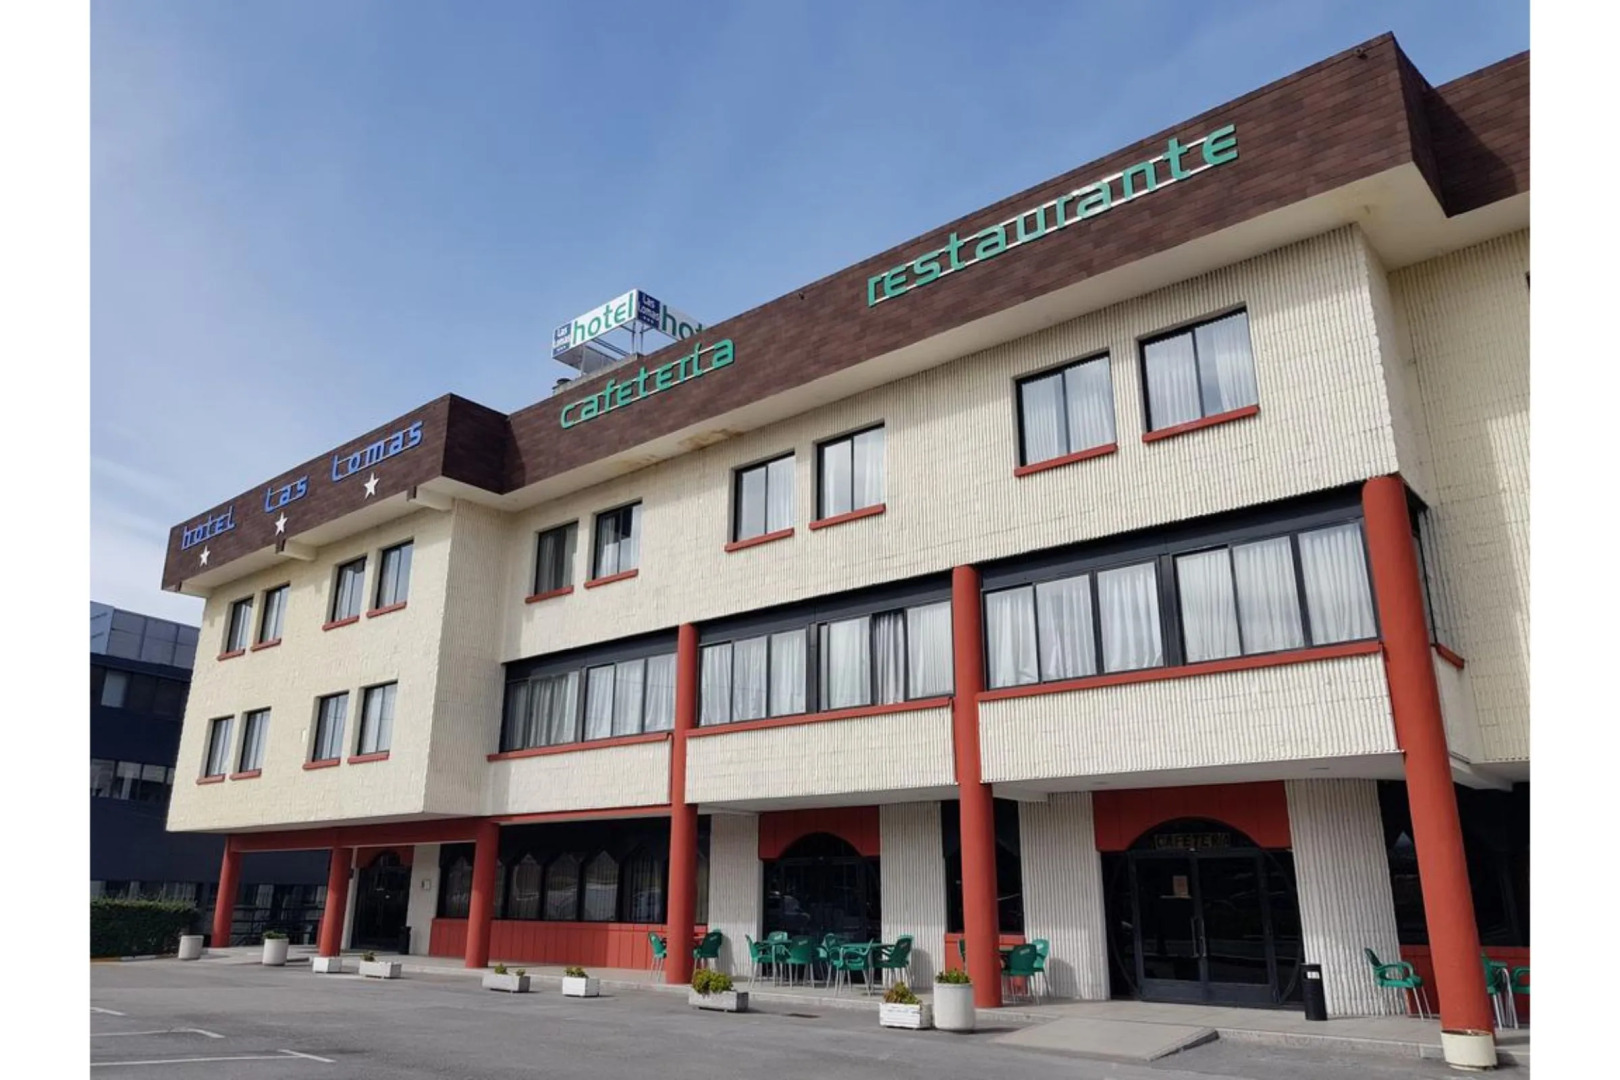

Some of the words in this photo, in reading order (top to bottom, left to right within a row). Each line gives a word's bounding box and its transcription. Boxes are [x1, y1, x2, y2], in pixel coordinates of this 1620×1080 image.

[867, 124, 1238, 307] restaurante
[573, 292, 633, 344] hotel
[182, 506, 236, 550] hotel
